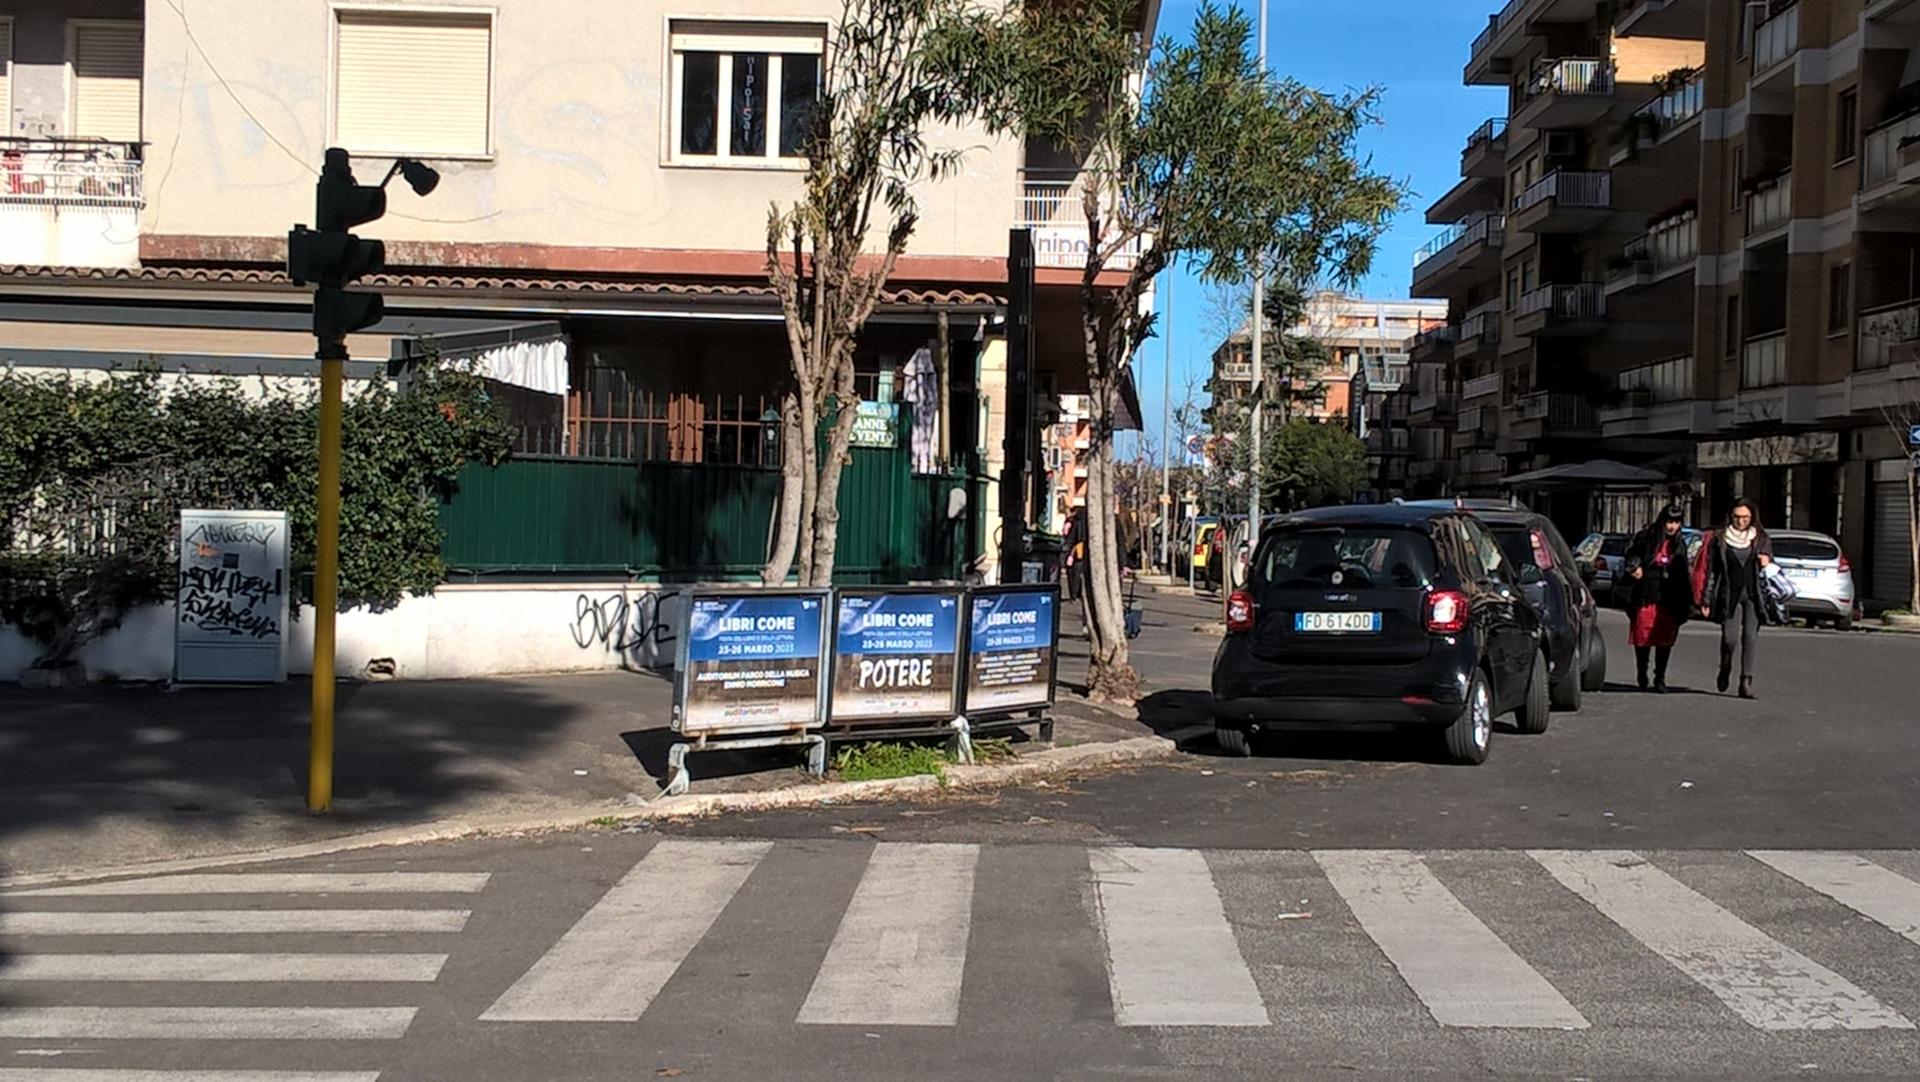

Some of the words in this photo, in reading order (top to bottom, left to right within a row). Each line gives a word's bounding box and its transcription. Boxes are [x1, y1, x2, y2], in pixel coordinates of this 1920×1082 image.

[720, 617, 754, 631] LIBRI
[757, 616, 795, 631] COME
[863, 614, 896, 627] LIBRI
[898, 613, 934, 627] COME
[987, 613, 1011, 625] LIBRI
[1012, 611, 1037, 624] COME
[744, 644, 774, 654] MARZO
[775, 643, 795, 653] 2023
[886, 640, 914, 648] MARZO
[914, 639, 933, 648] 2023
[697, 671, 740, 681] AUDITORIUM
[741, 671, 764, 679] PARCO
[765, 670, 785, 679] DELLA
[860, 658, 933, 688] POTERE
